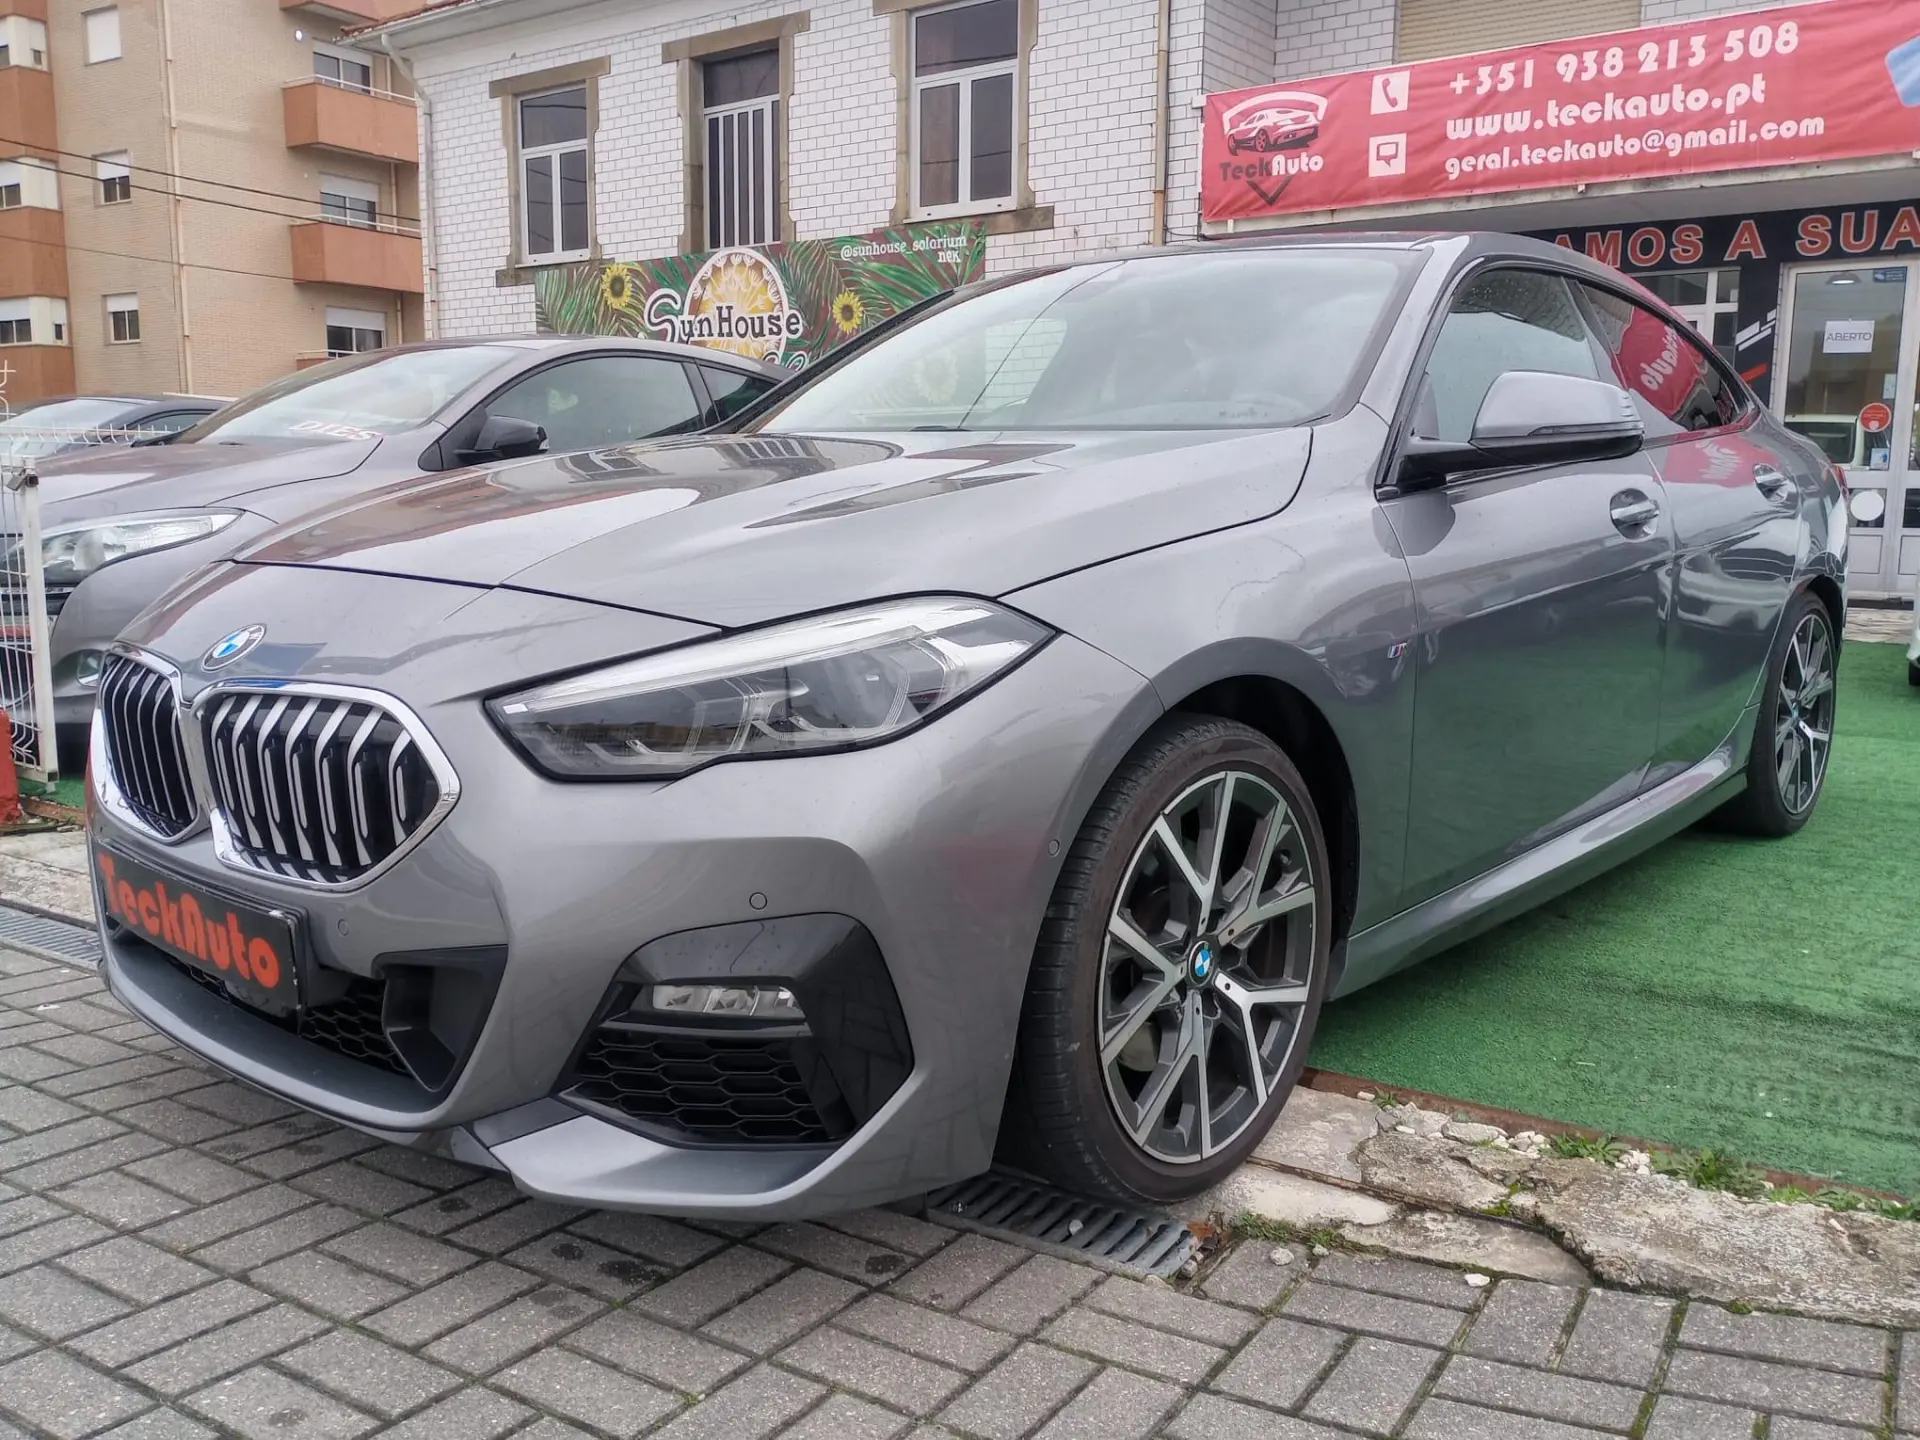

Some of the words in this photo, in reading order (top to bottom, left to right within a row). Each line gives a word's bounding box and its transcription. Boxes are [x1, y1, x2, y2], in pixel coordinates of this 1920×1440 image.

[1449, 59, 1534, 95] +351
[1556, 46, 1624, 83] 938
[1638, 35, 1708, 73] 213
[1723, 21, 1799, 61] 508
[1446, 72, 1766, 140] www.teckauto.pt
[1219, 151, 1324, 182] TeckAuto
[1445, 116, 1825, 181] geral.teckauto@gmail.com
[1722, 219, 1767, 262] A
[1795, 206, 1920, 258] SUA
[645, 289, 802, 344] SunHouse
[1825, 331, 1873, 342] ABERTO
[100, 852, 282, 989] TeckAuto
